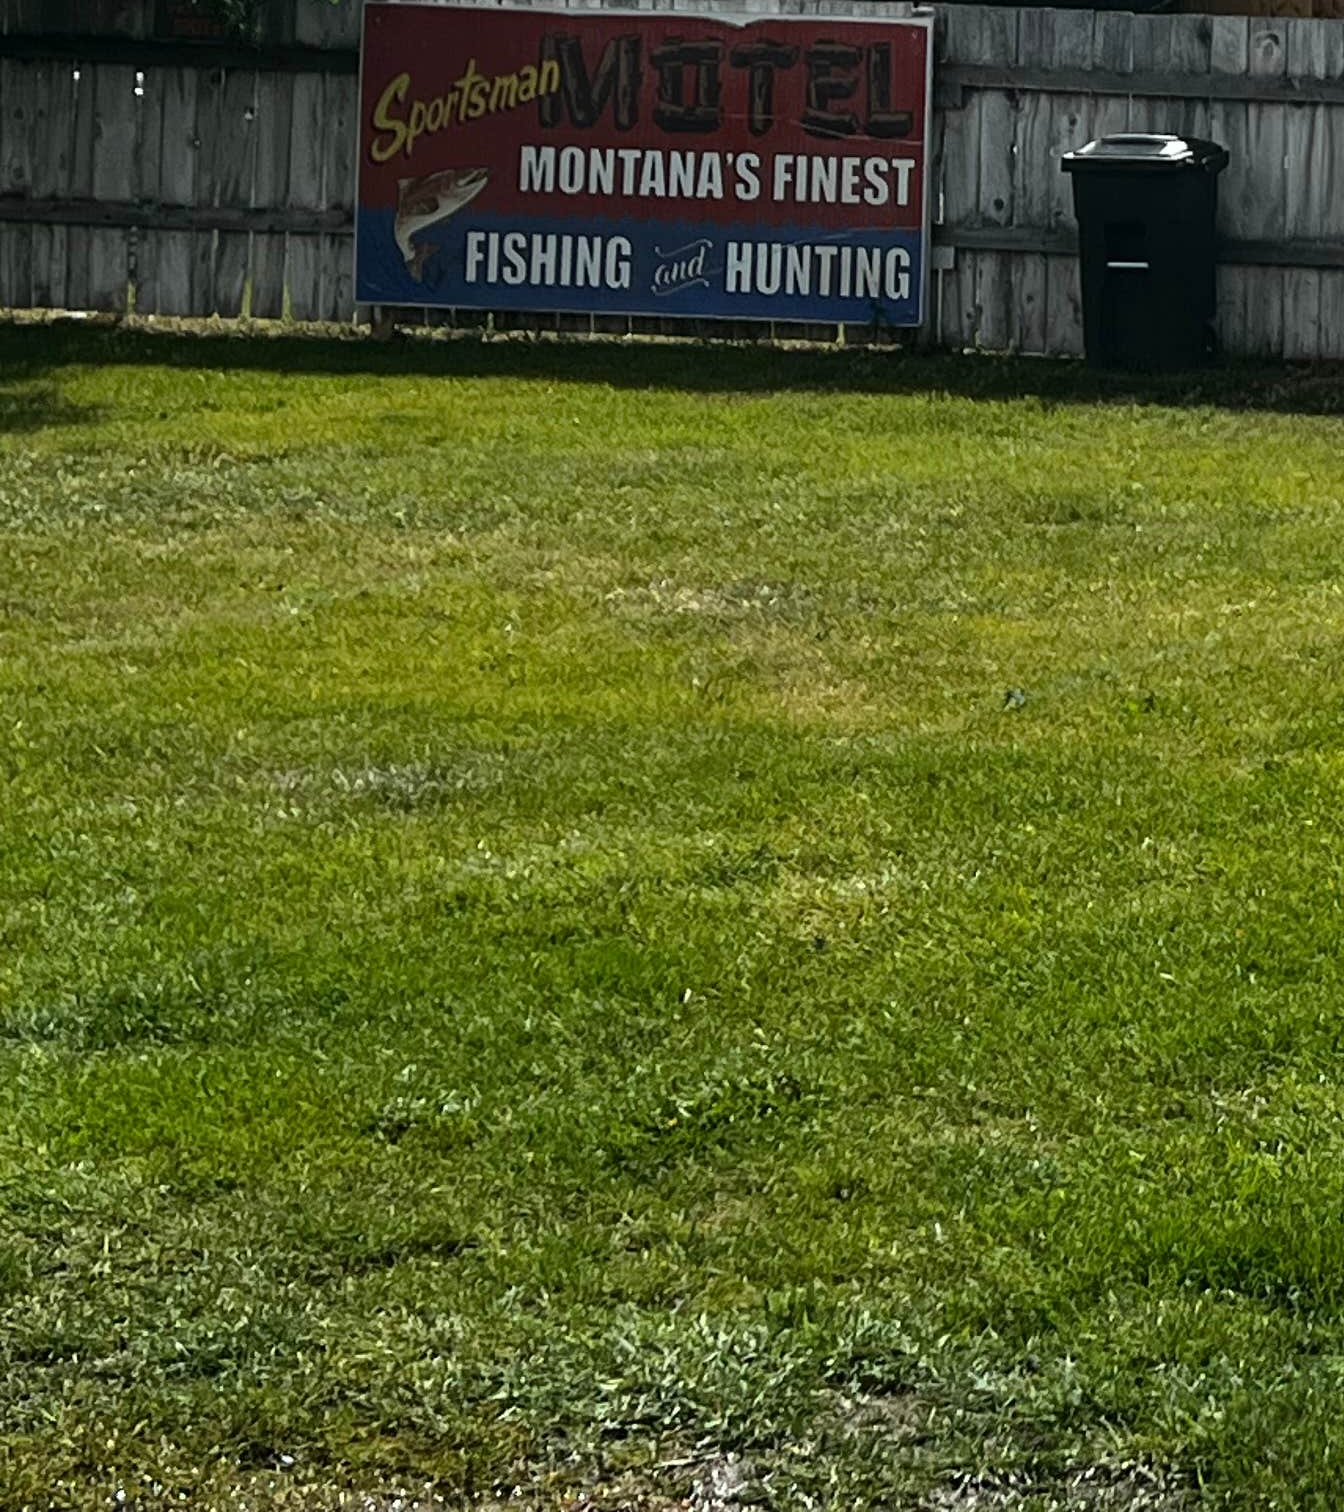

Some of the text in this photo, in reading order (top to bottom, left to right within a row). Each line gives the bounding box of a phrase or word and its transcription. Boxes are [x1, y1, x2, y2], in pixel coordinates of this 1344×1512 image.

[370, 31, 915, 163] Sportsman MOTEL
[520, 146, 915, 207] MONTANA'S FINEST
[465, 231, 910, 300] FISHING and HUNTING
